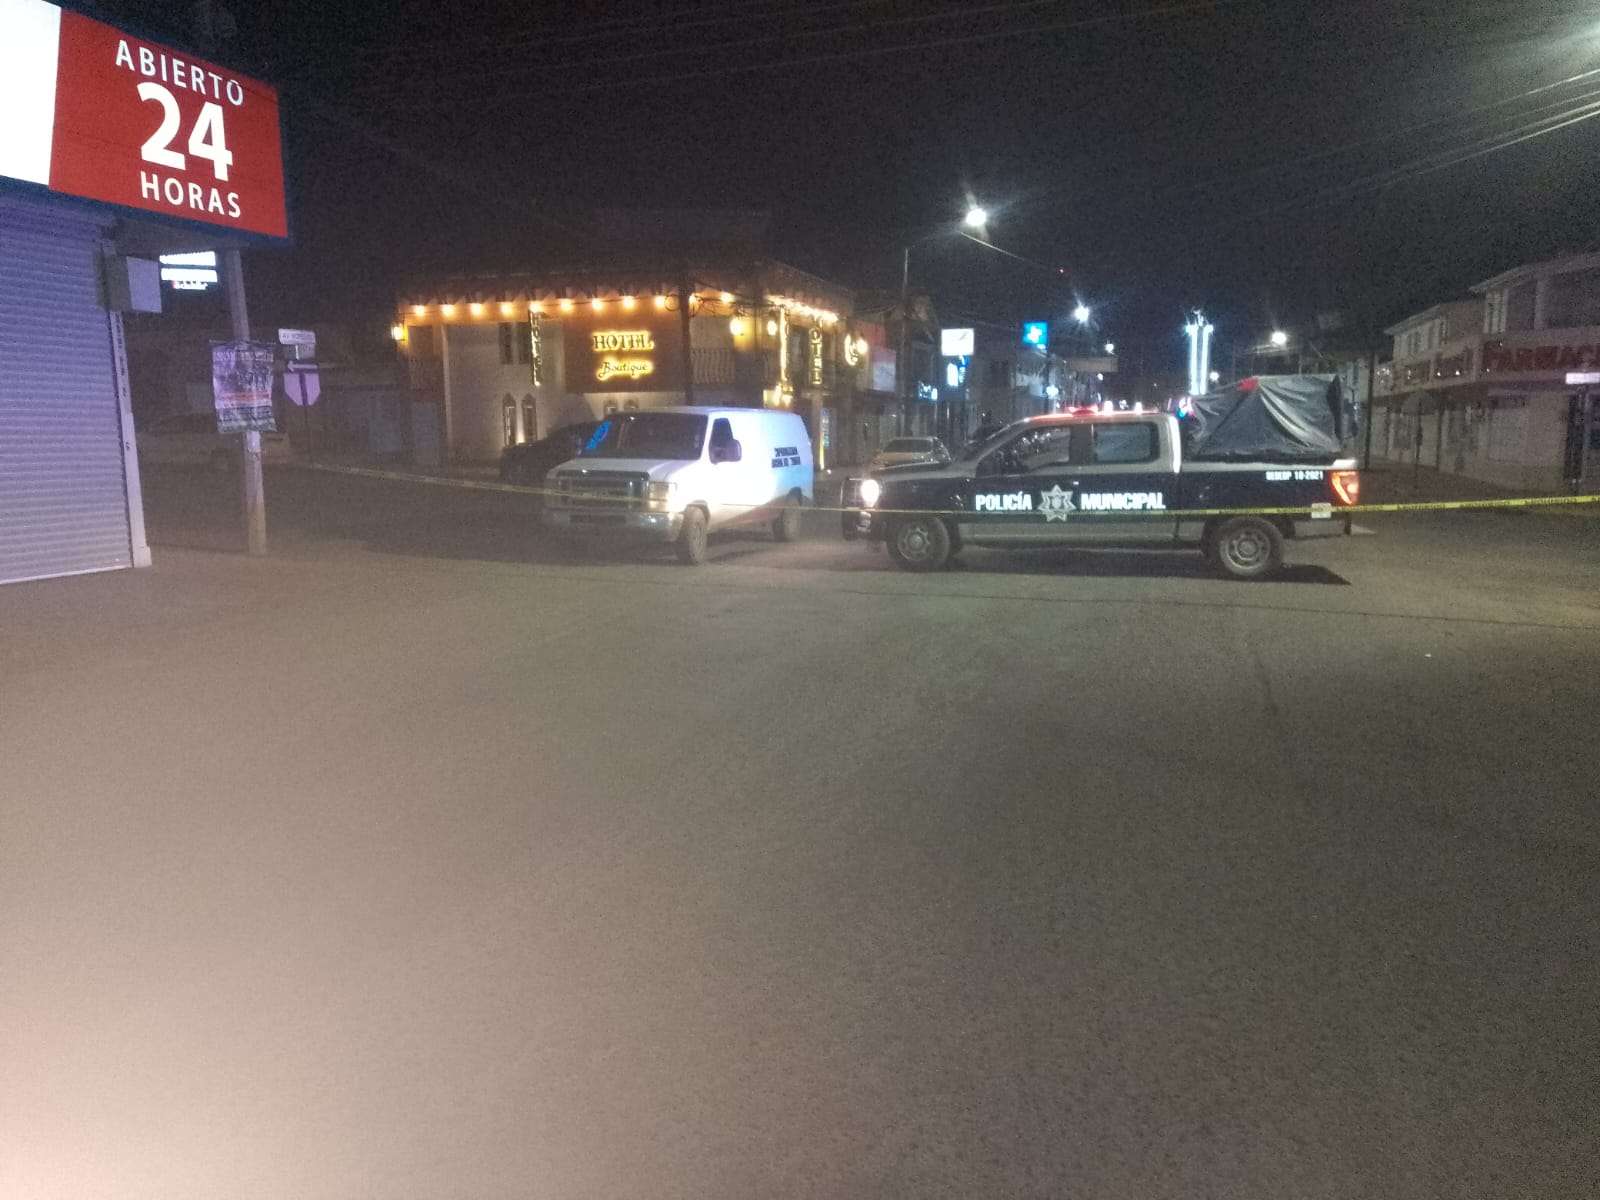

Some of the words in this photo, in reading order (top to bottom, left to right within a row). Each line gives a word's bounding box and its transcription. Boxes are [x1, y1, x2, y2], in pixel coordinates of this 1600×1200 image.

[115, 39, 244, 106] ABIERTO
[136, 81, 233, 182] 24
[140, 171, 242, 218] HORAS
[592, 331, 655, 351] HOTEL
[596, 356, 653, 380] Boutique
[975, 491, 1033, 511] POLICÍA
[1080, 492, 1167, 510] MUNICIPAL
